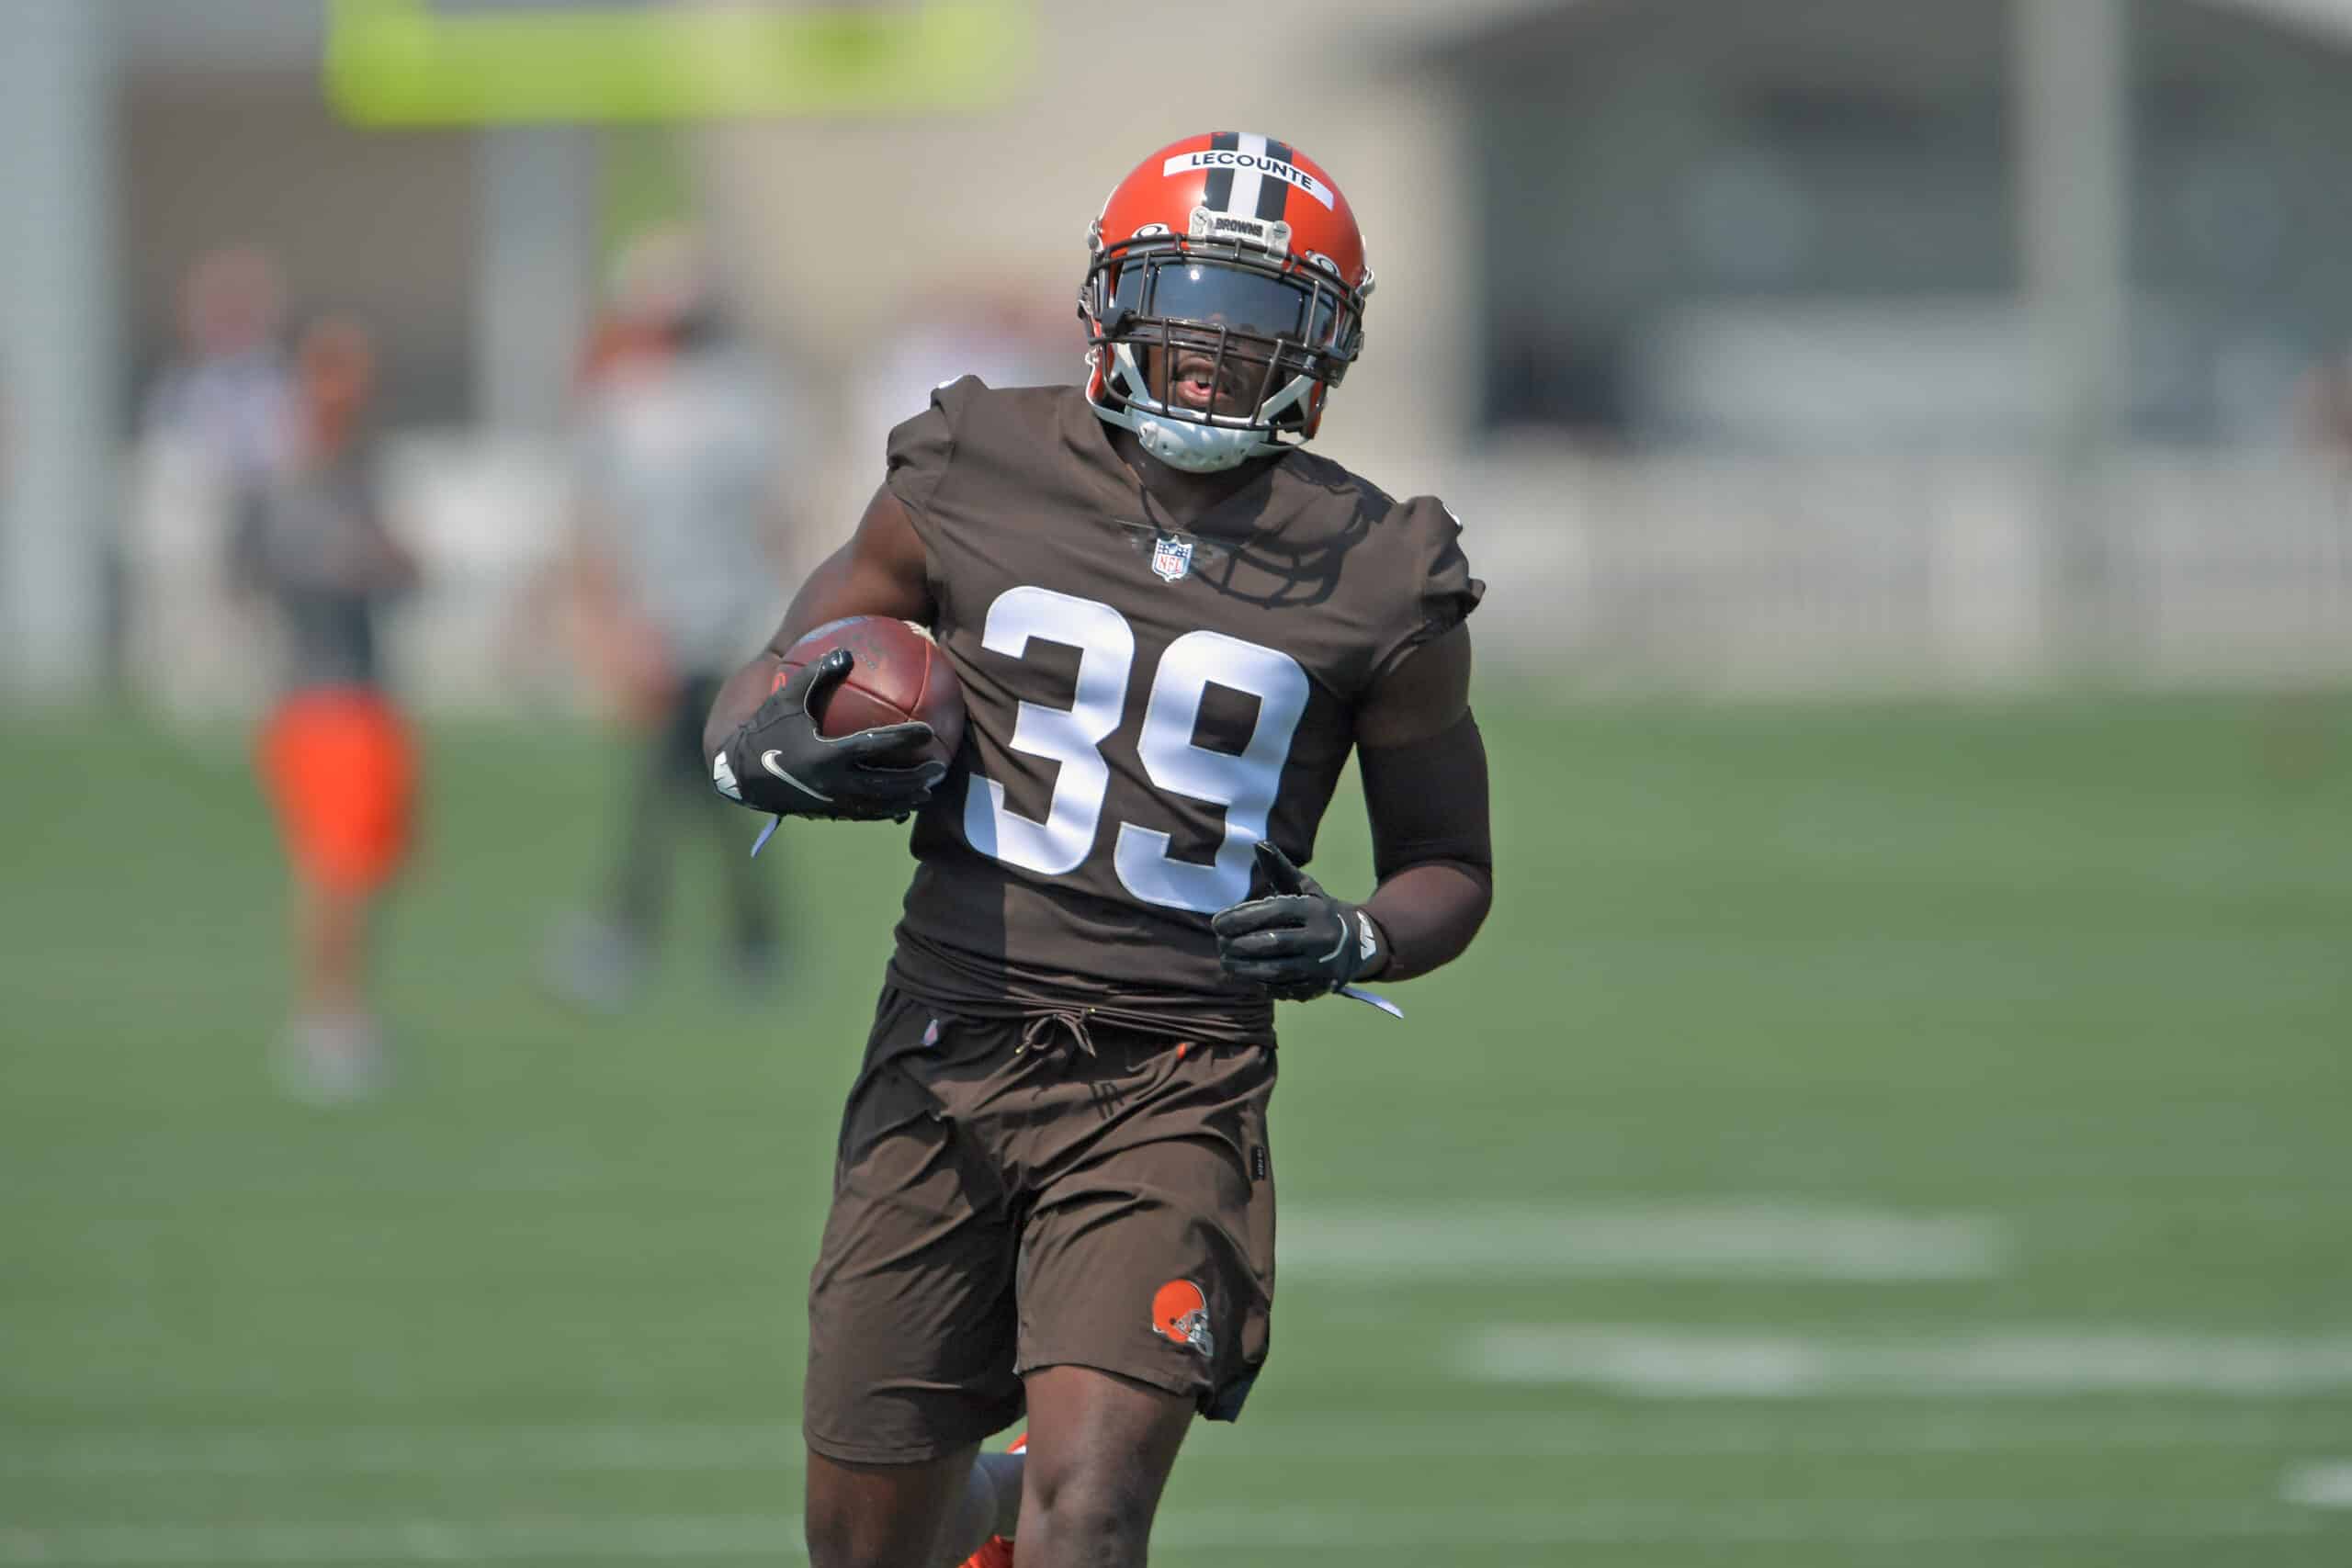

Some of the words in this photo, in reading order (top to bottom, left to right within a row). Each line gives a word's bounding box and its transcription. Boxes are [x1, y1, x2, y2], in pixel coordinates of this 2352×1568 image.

[1192, 152, 1312, 190] LECOUNTE
[1216, 217, 1263, 237] BROWNS
[964, 586, 1310, 915] 39
